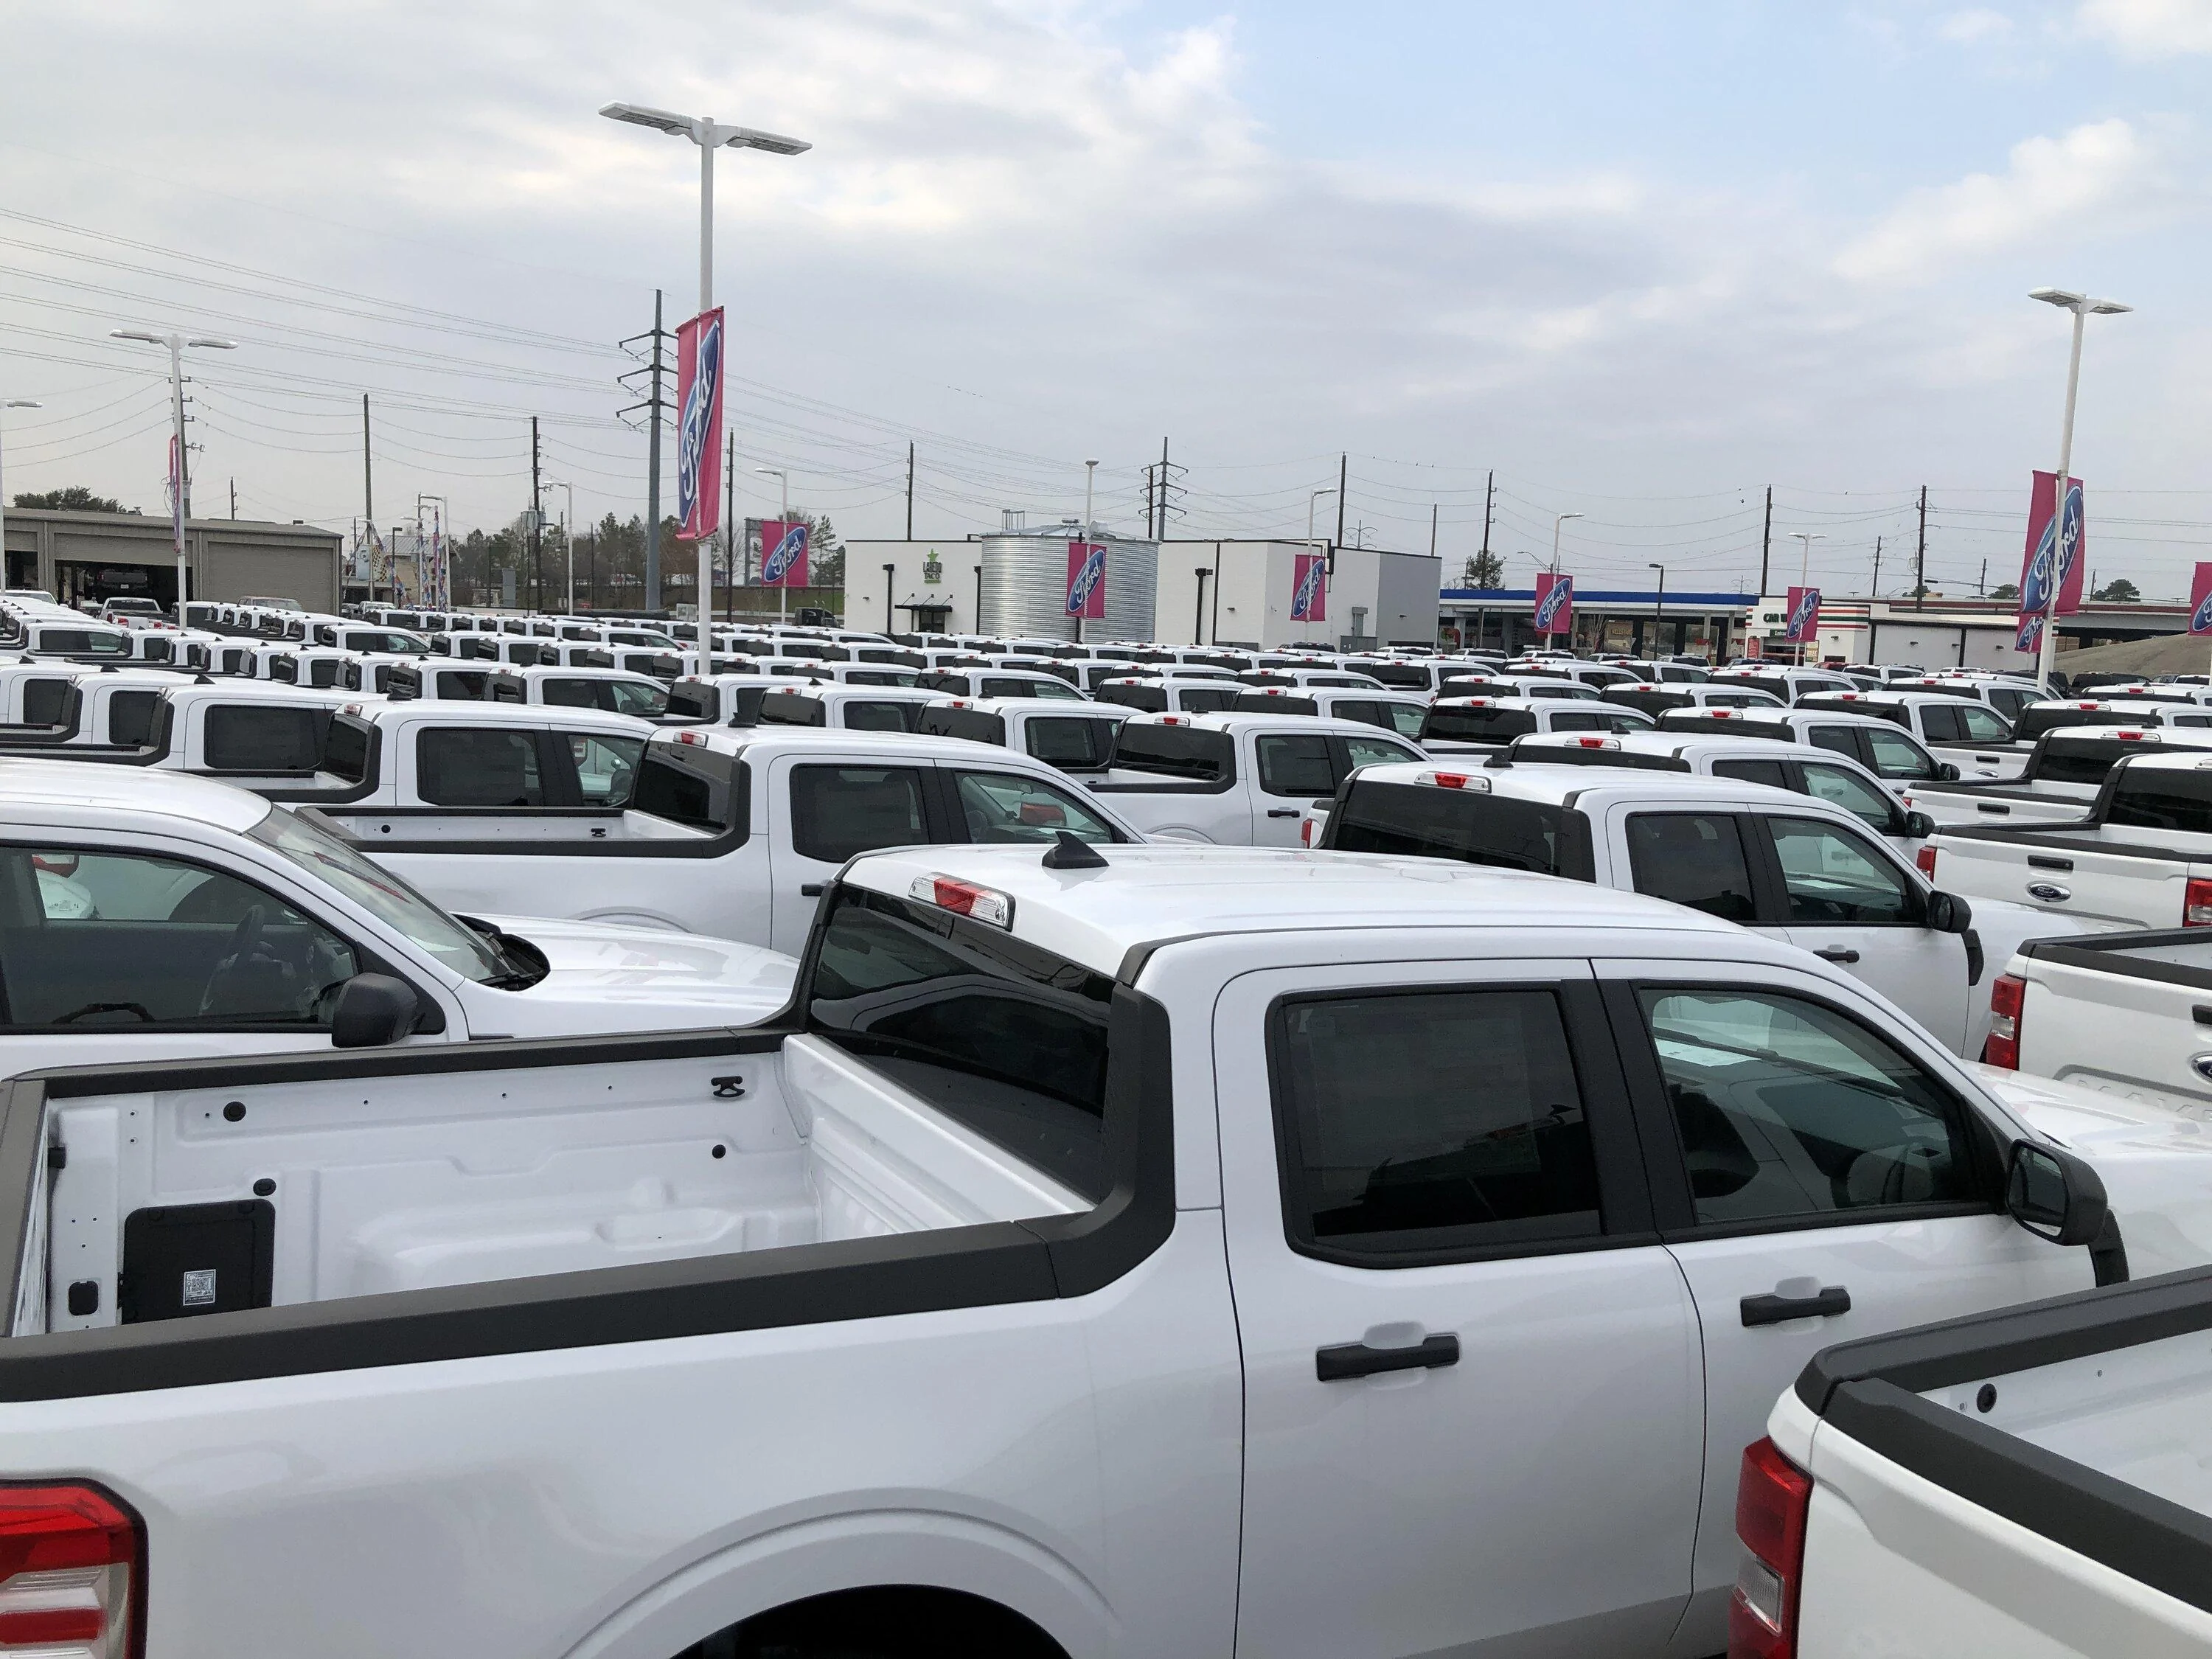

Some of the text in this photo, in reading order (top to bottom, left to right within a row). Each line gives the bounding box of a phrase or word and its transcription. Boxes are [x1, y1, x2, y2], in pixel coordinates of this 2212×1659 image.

[681, 353, 712, 501] Ford
[771, 535, 802, 575] Ford
[2034, 505, 2079, 601] Ford
[1075, 559, 1101, 604] Ford
[1298, 568, 1321, 610] Ford
[1542, 585, 1567, 622] Ford
[1763, 613, 1780, 623] CAR
[1793, 597, 1815, 632] Ford
